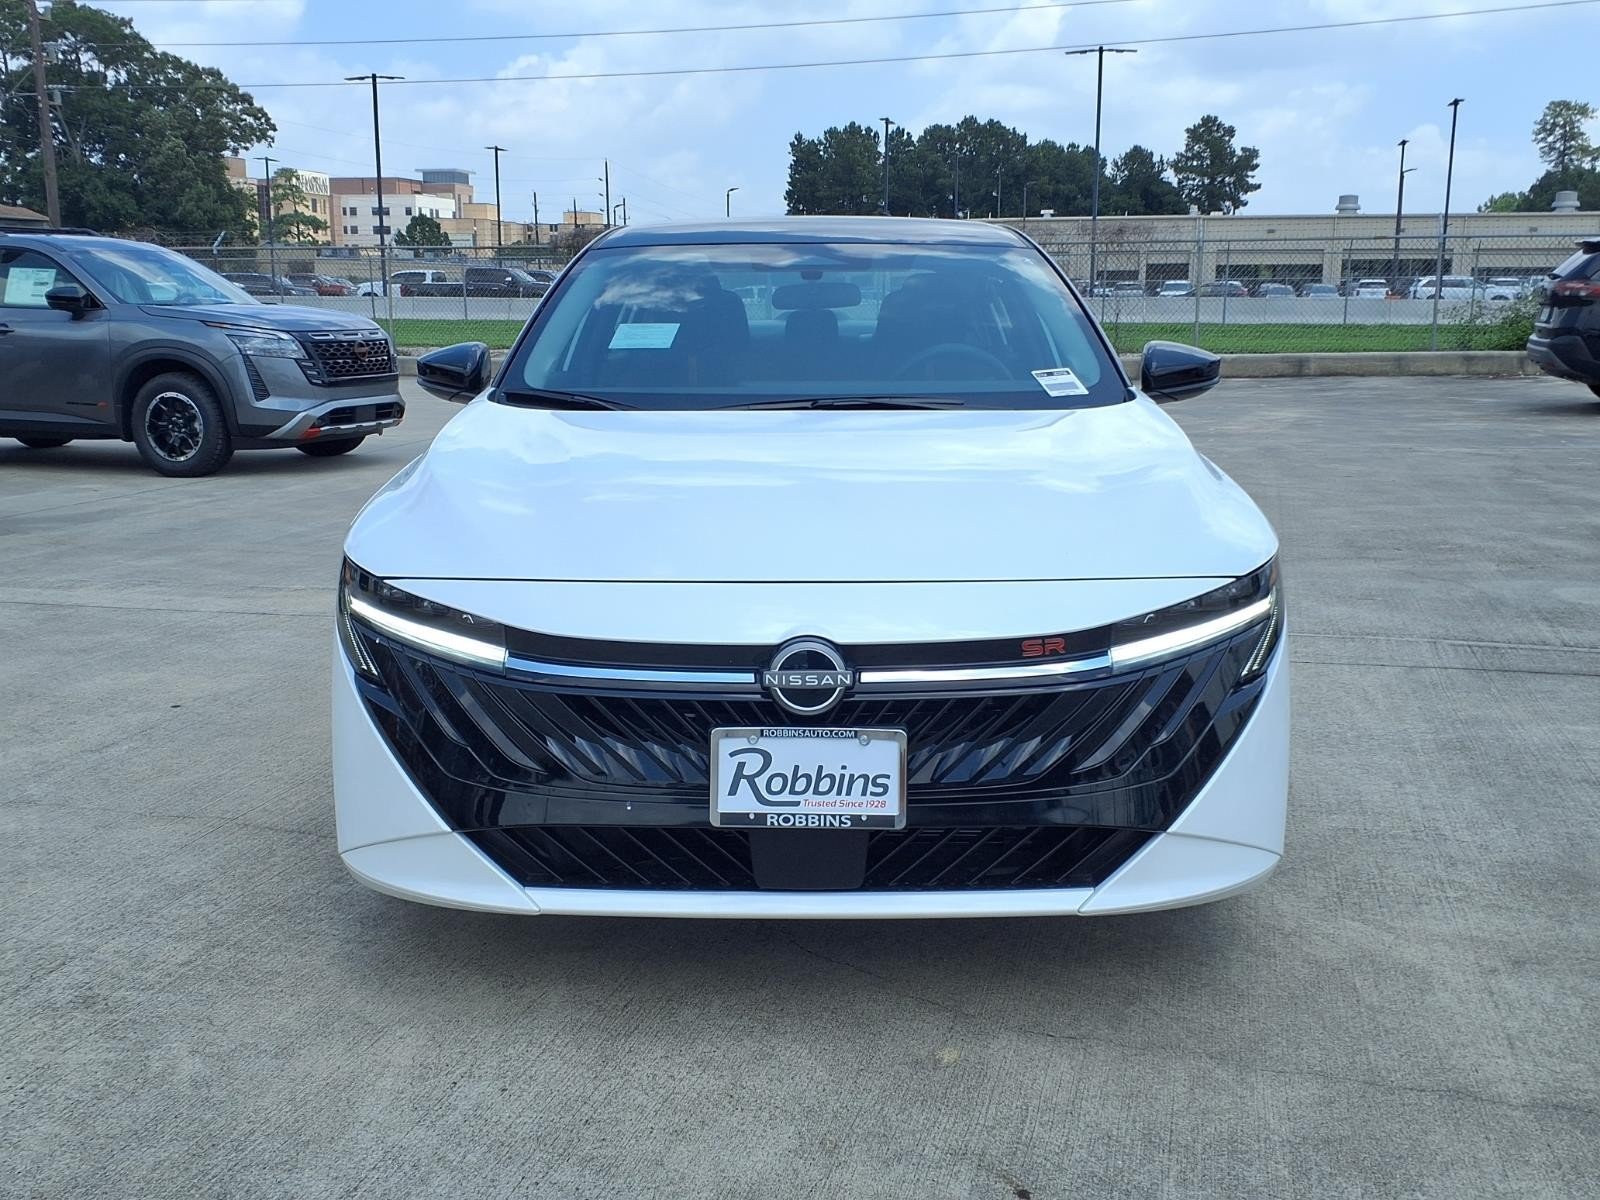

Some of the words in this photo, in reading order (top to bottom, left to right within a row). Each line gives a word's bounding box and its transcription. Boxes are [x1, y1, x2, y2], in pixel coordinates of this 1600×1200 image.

[1022, 638, 1065, 656] SR
[765, 674, 850, 686] NISSAN
[763, 729, 855, 738] ROBBINSAUTO.COM
[727, 747, 891, 807] Robbins
[803, 799, 837, 808] Trusted
[838, 799, 864, 808] Since
[865, 800, 887, 808] 1928
[766, 813, 852, 827] ROBBINS
